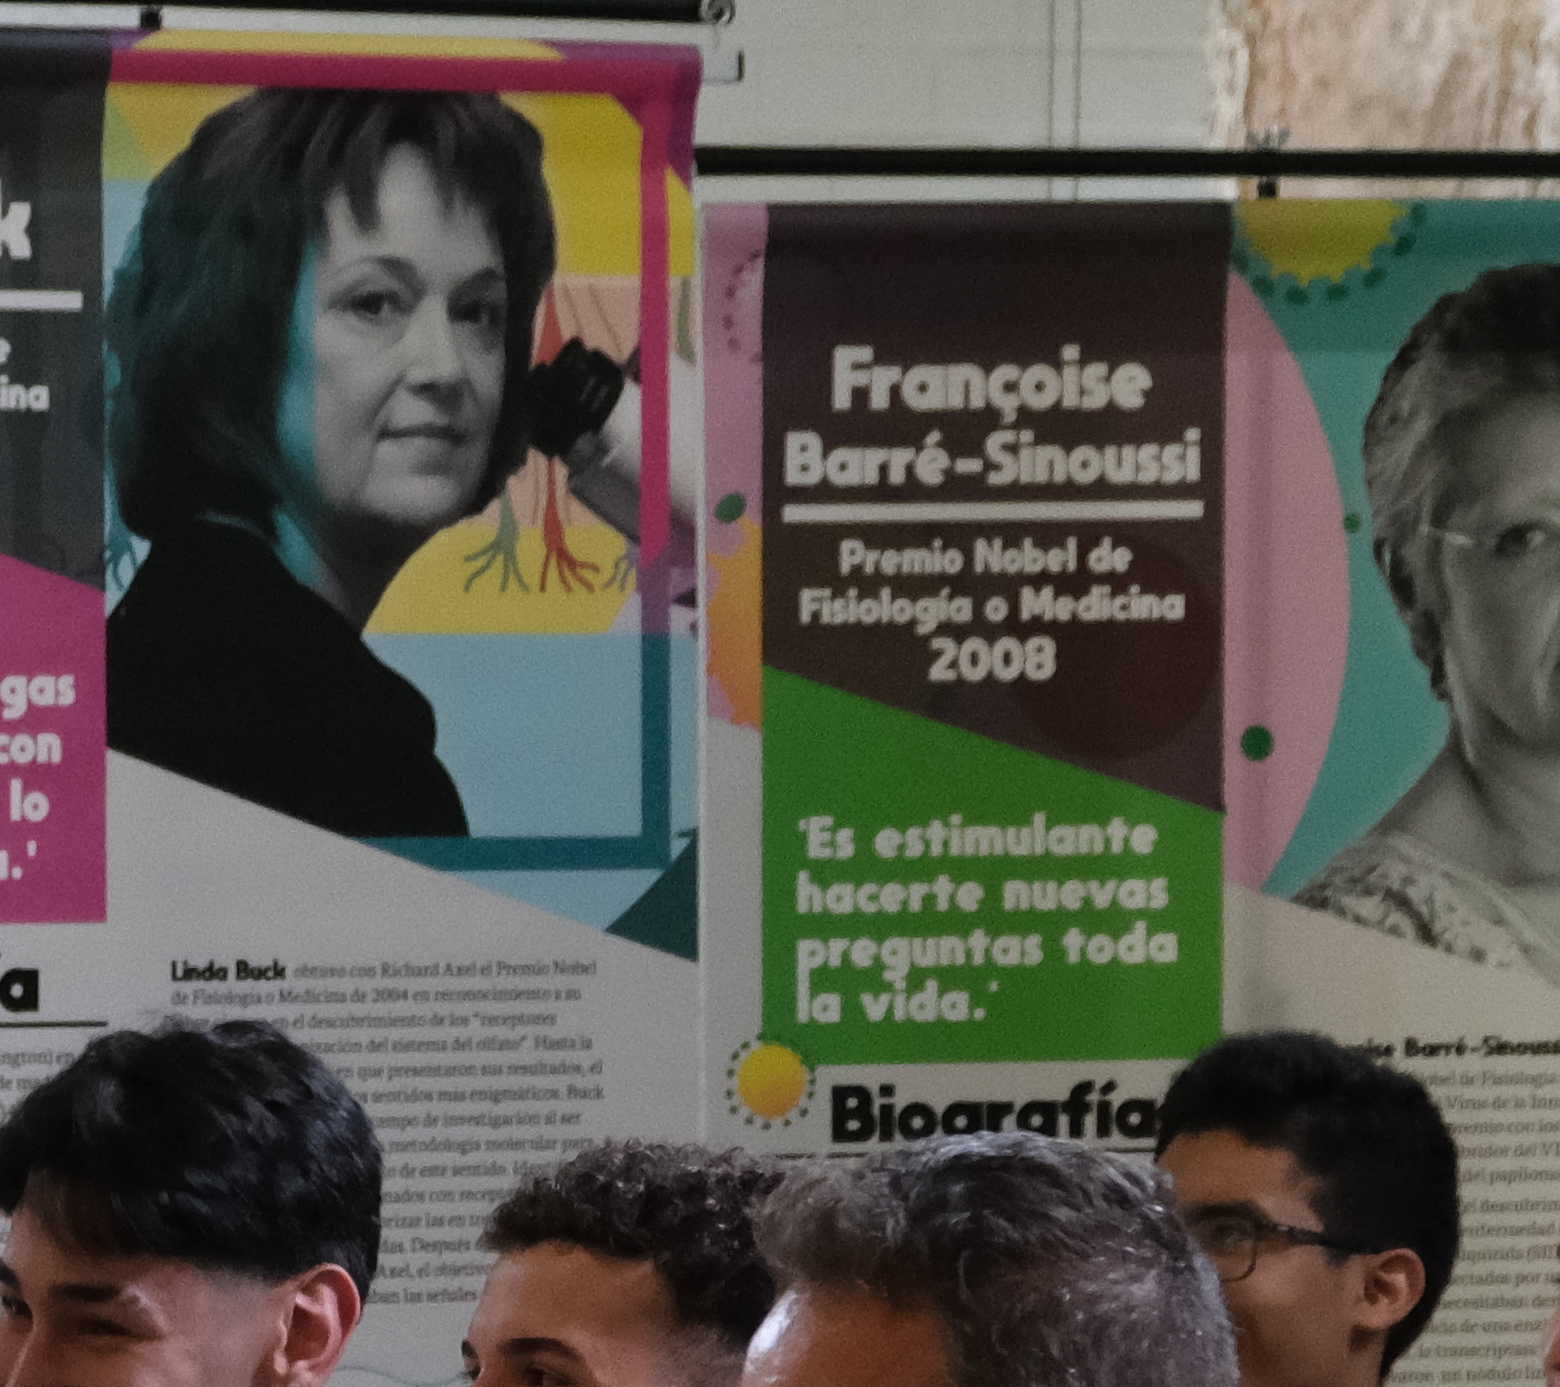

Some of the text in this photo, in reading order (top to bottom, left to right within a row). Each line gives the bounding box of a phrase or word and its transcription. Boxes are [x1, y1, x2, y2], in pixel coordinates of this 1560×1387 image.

[832, 344, 1153, 424] Françoise
[784, 427, 1201, 487] Barré-Sinoussi
[839, 536, 1133, 576] Premio Nobel de
[799, 584, 1185, 635] Fisiología o Medicina
[929, 636, 1056, 682] 2008
[10, 778, 50, 822] lo
[874, 812, 1158, 858] estimulante
[796, 870, 1169, 914] hacerte nuevas
[171, 959, 286, 982] Linda Buck
[796, 920, 1178, 980] preguntas toda
[796, 977, 841, 1024] la
